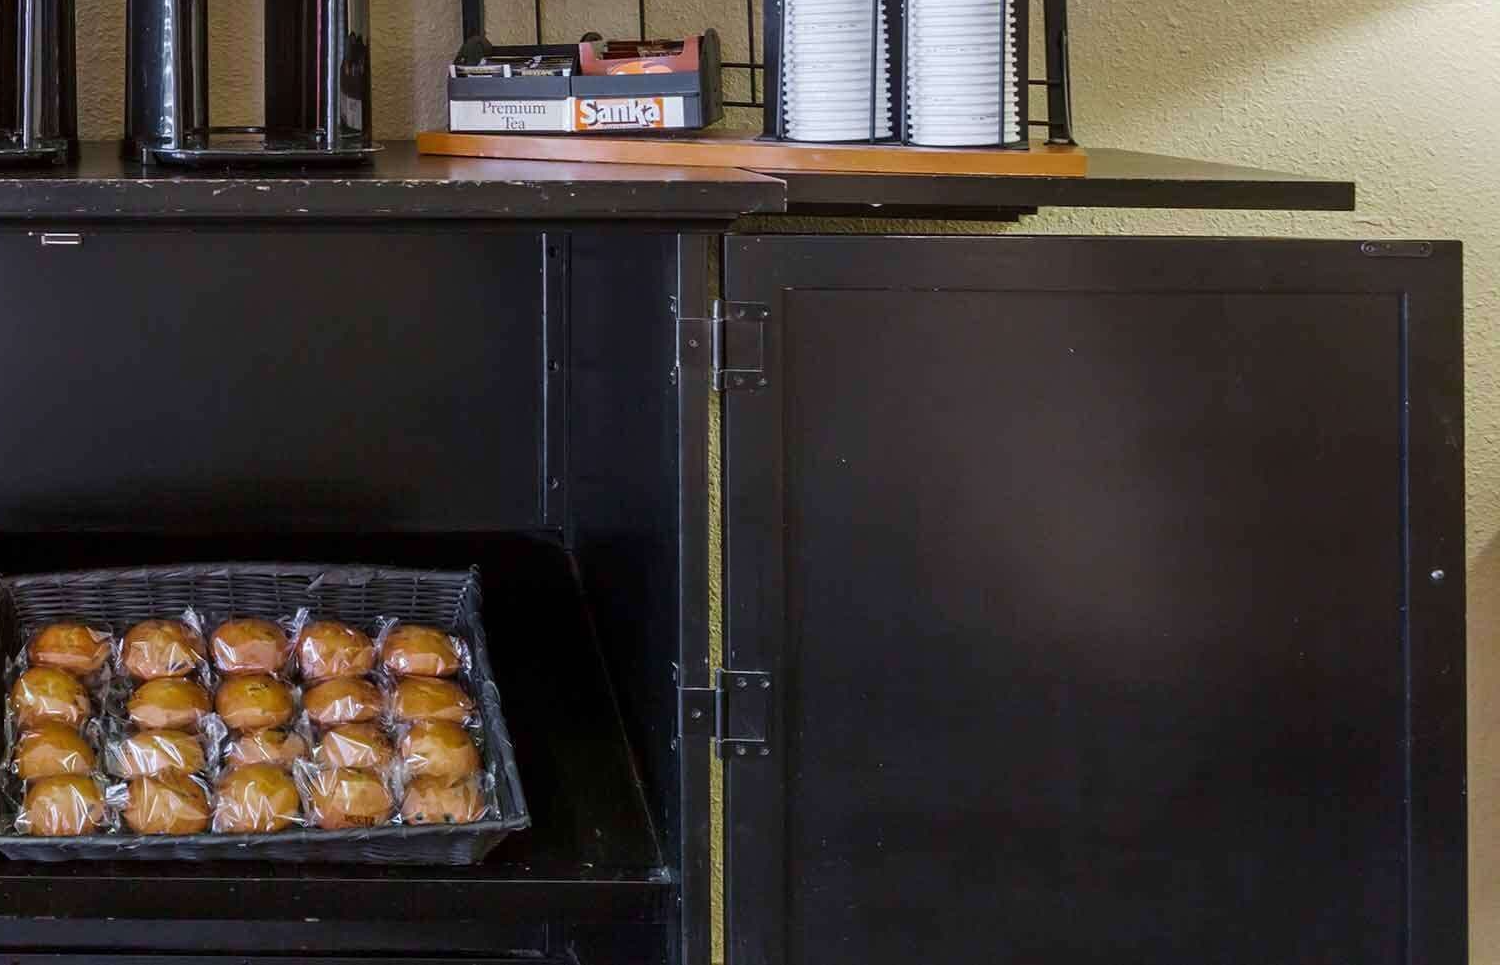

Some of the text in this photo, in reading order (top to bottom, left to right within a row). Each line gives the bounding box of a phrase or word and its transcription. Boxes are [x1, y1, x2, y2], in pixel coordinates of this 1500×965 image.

[482, 101, 546, 116] Premium
[580, 98, 661, 128] Sanka
[502, 117, 525, 130] Tea
